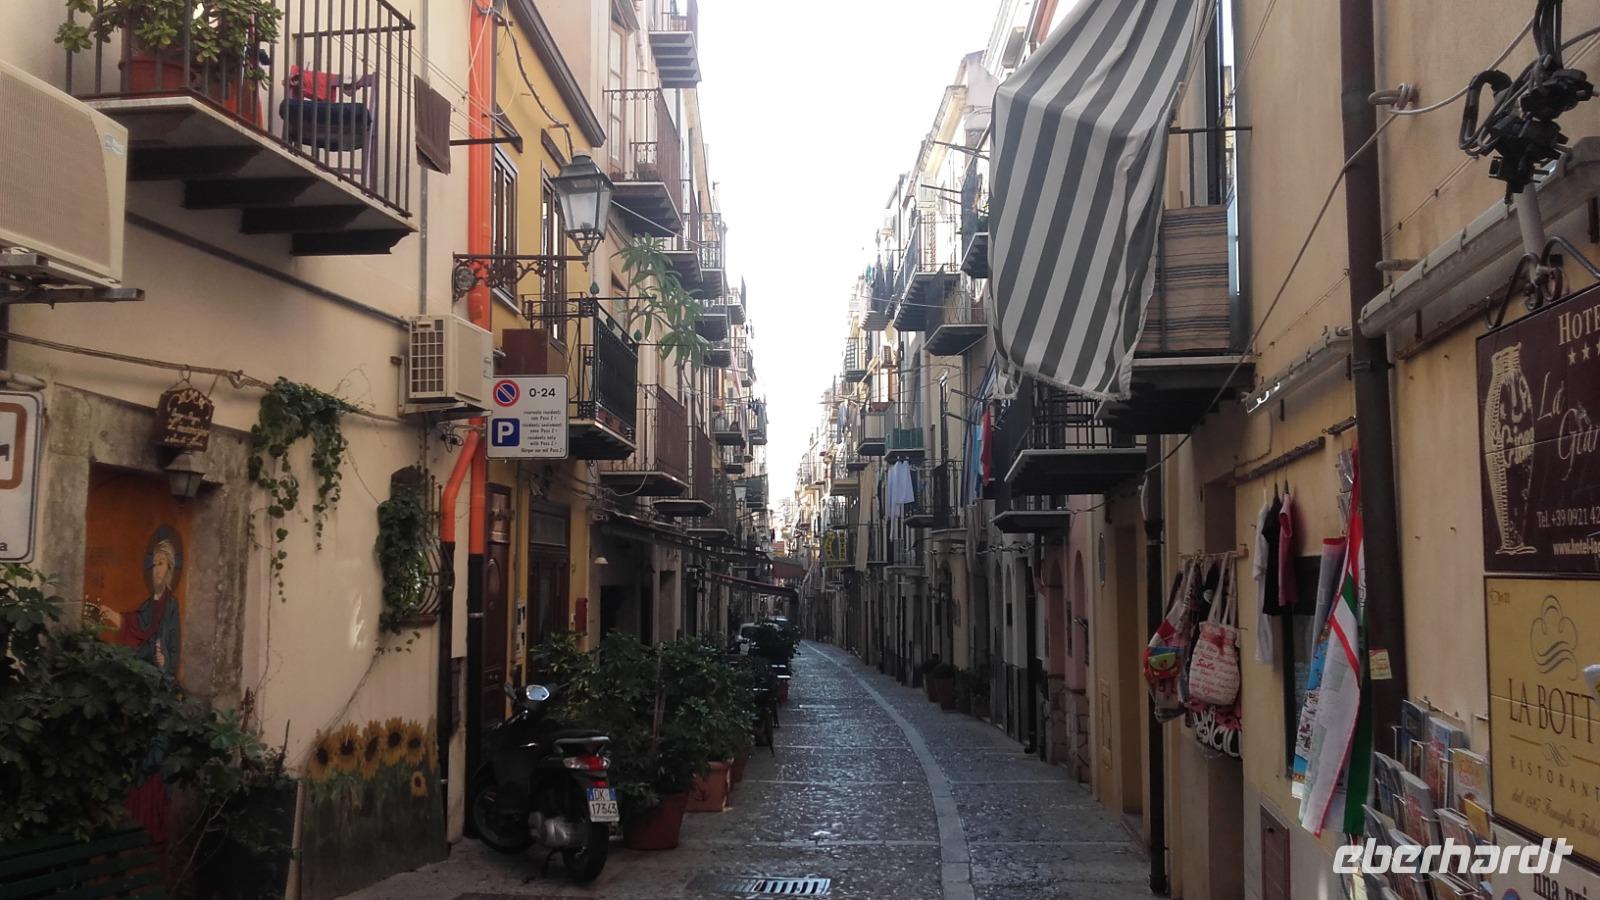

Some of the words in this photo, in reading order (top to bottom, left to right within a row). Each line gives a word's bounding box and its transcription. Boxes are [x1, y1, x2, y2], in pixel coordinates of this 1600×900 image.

[1558, 304, 1600, 346] HOTE
[529, 388, 556, 397] 0-24
[1537, 370, 1566, 421] La
[497, 421, 515, 444] P
[1551, 509, 1566, 527] +39
[1508, 678, 1532, 726] LA
[1537, 684, 1595, 744] BOTT
[1511, 755, 1600, 802] RISTORANT
